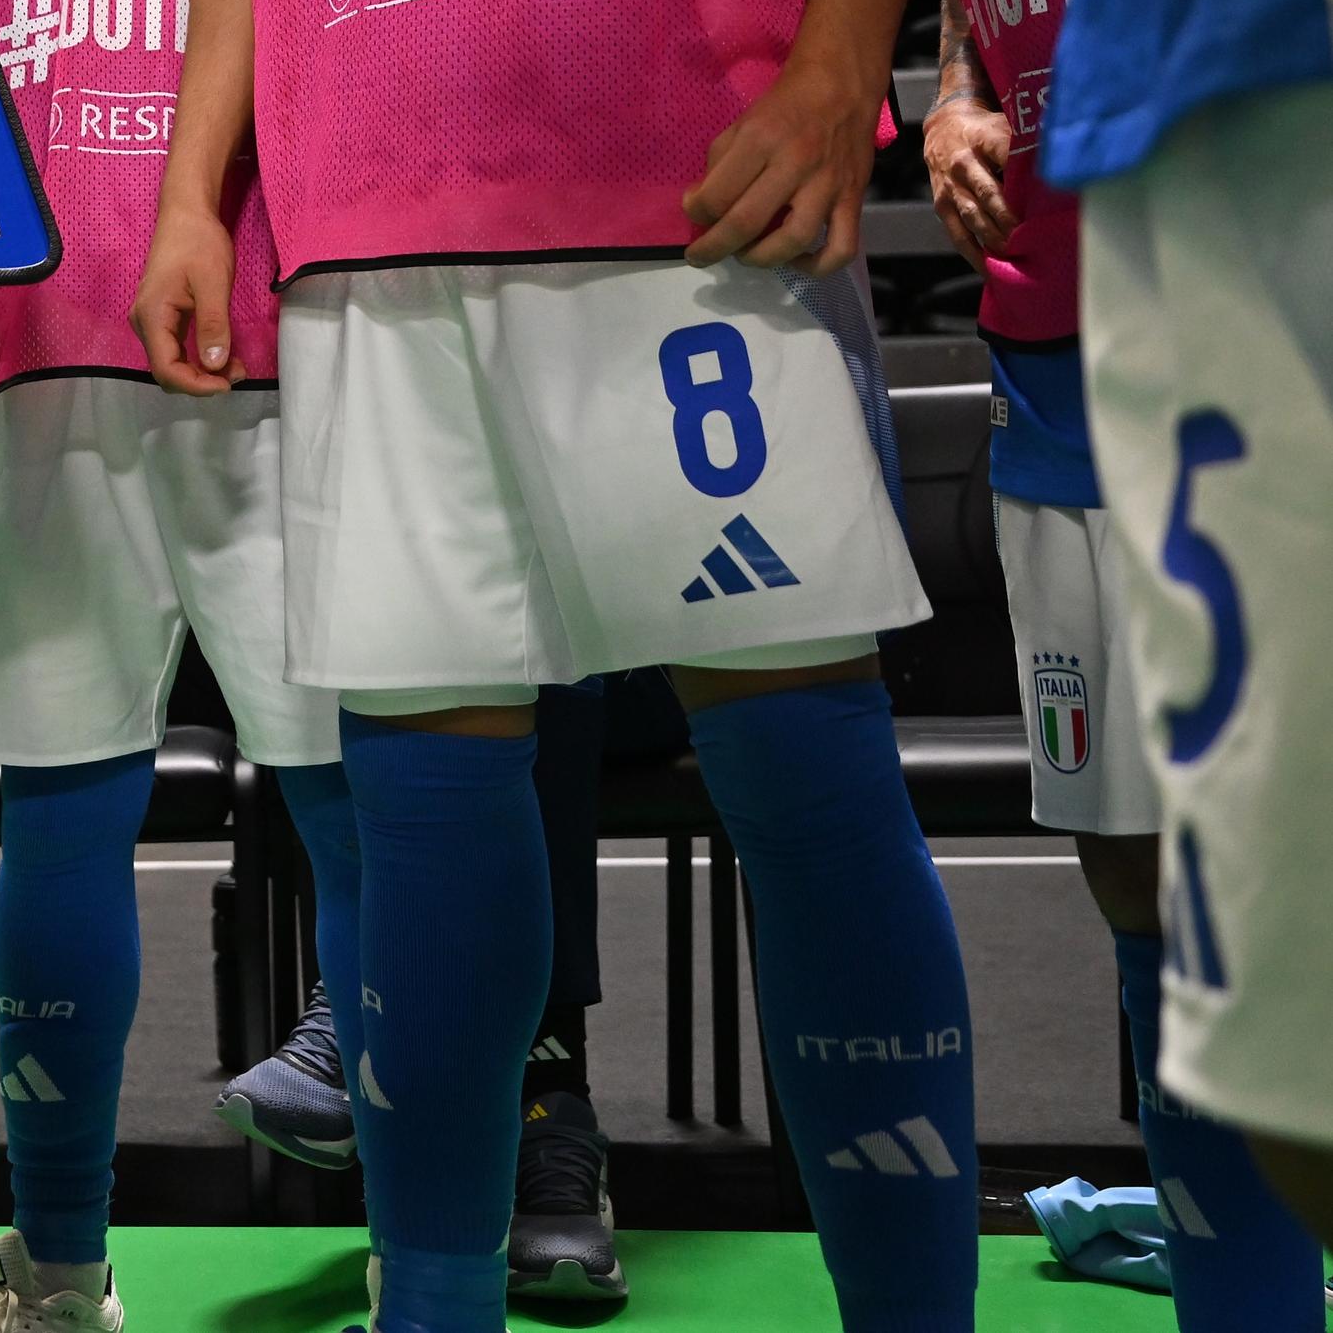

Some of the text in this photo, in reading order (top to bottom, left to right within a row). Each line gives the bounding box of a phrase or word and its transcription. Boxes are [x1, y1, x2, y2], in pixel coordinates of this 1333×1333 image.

[658, 322, 767, 498] 8
[1161, 403, 1249, 765] 5
[1039, 677, 1082, 698] ITALIA
[797, 1028, 961, 1062] ITALIA
